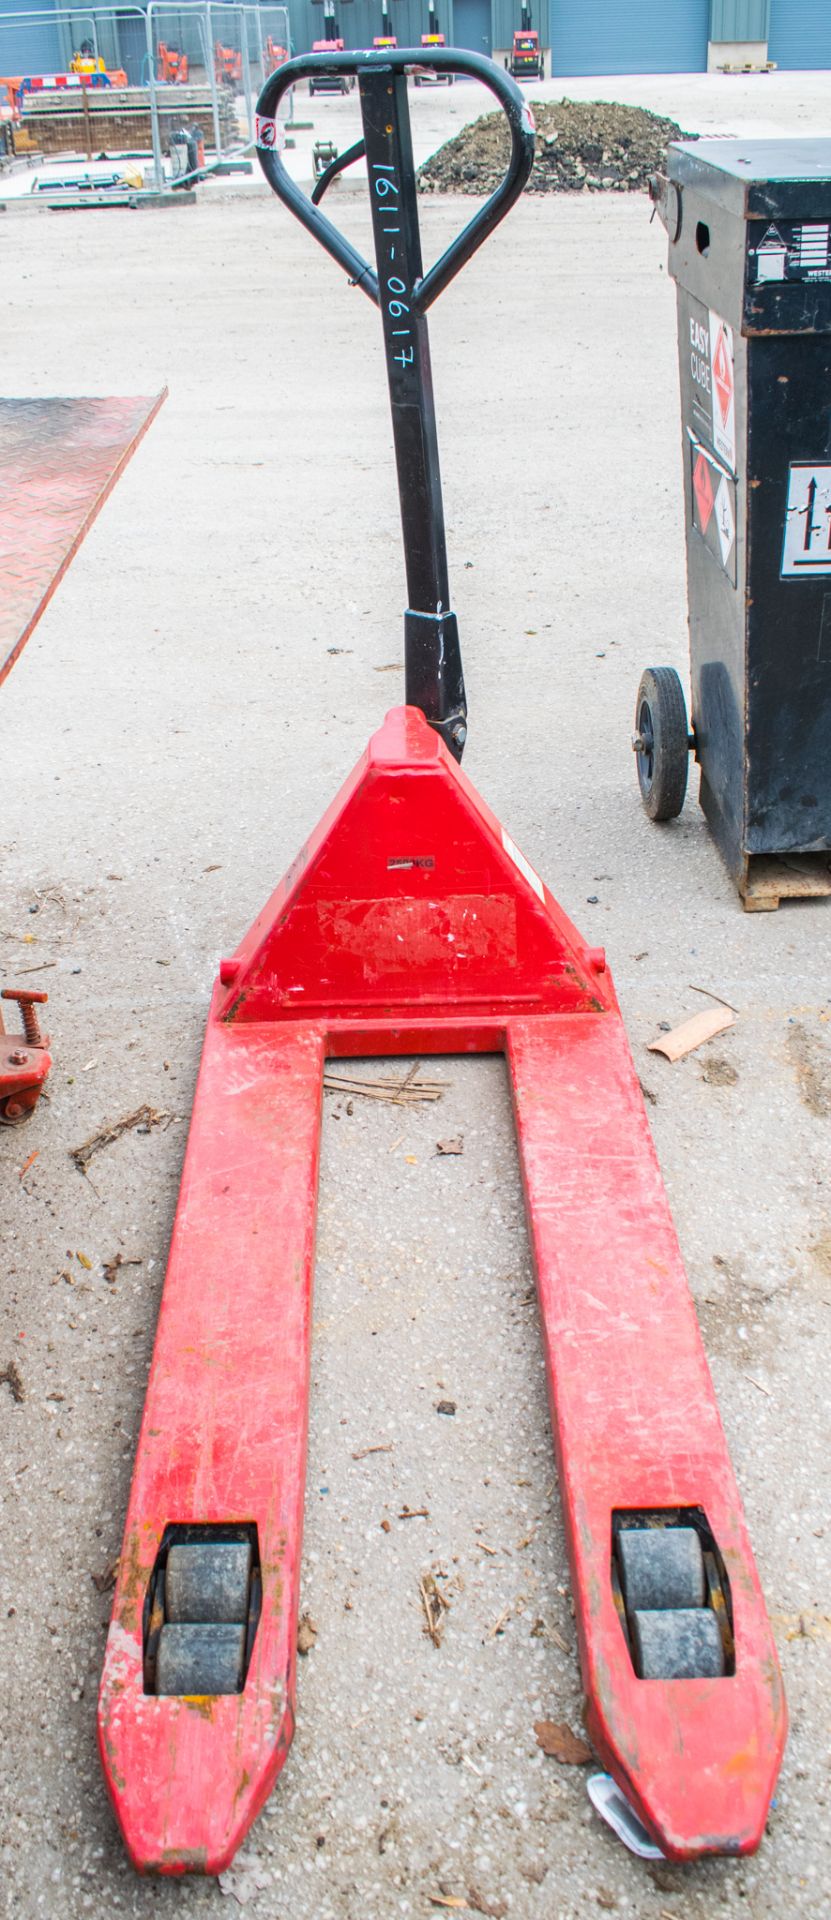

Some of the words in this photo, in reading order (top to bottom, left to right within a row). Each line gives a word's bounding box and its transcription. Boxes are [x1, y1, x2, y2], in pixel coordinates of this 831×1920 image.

[372, 164, 414, 368] 1611-0617
[689, 317, 709, 358] EASY
[690, 352, 712, 395] CUBE
